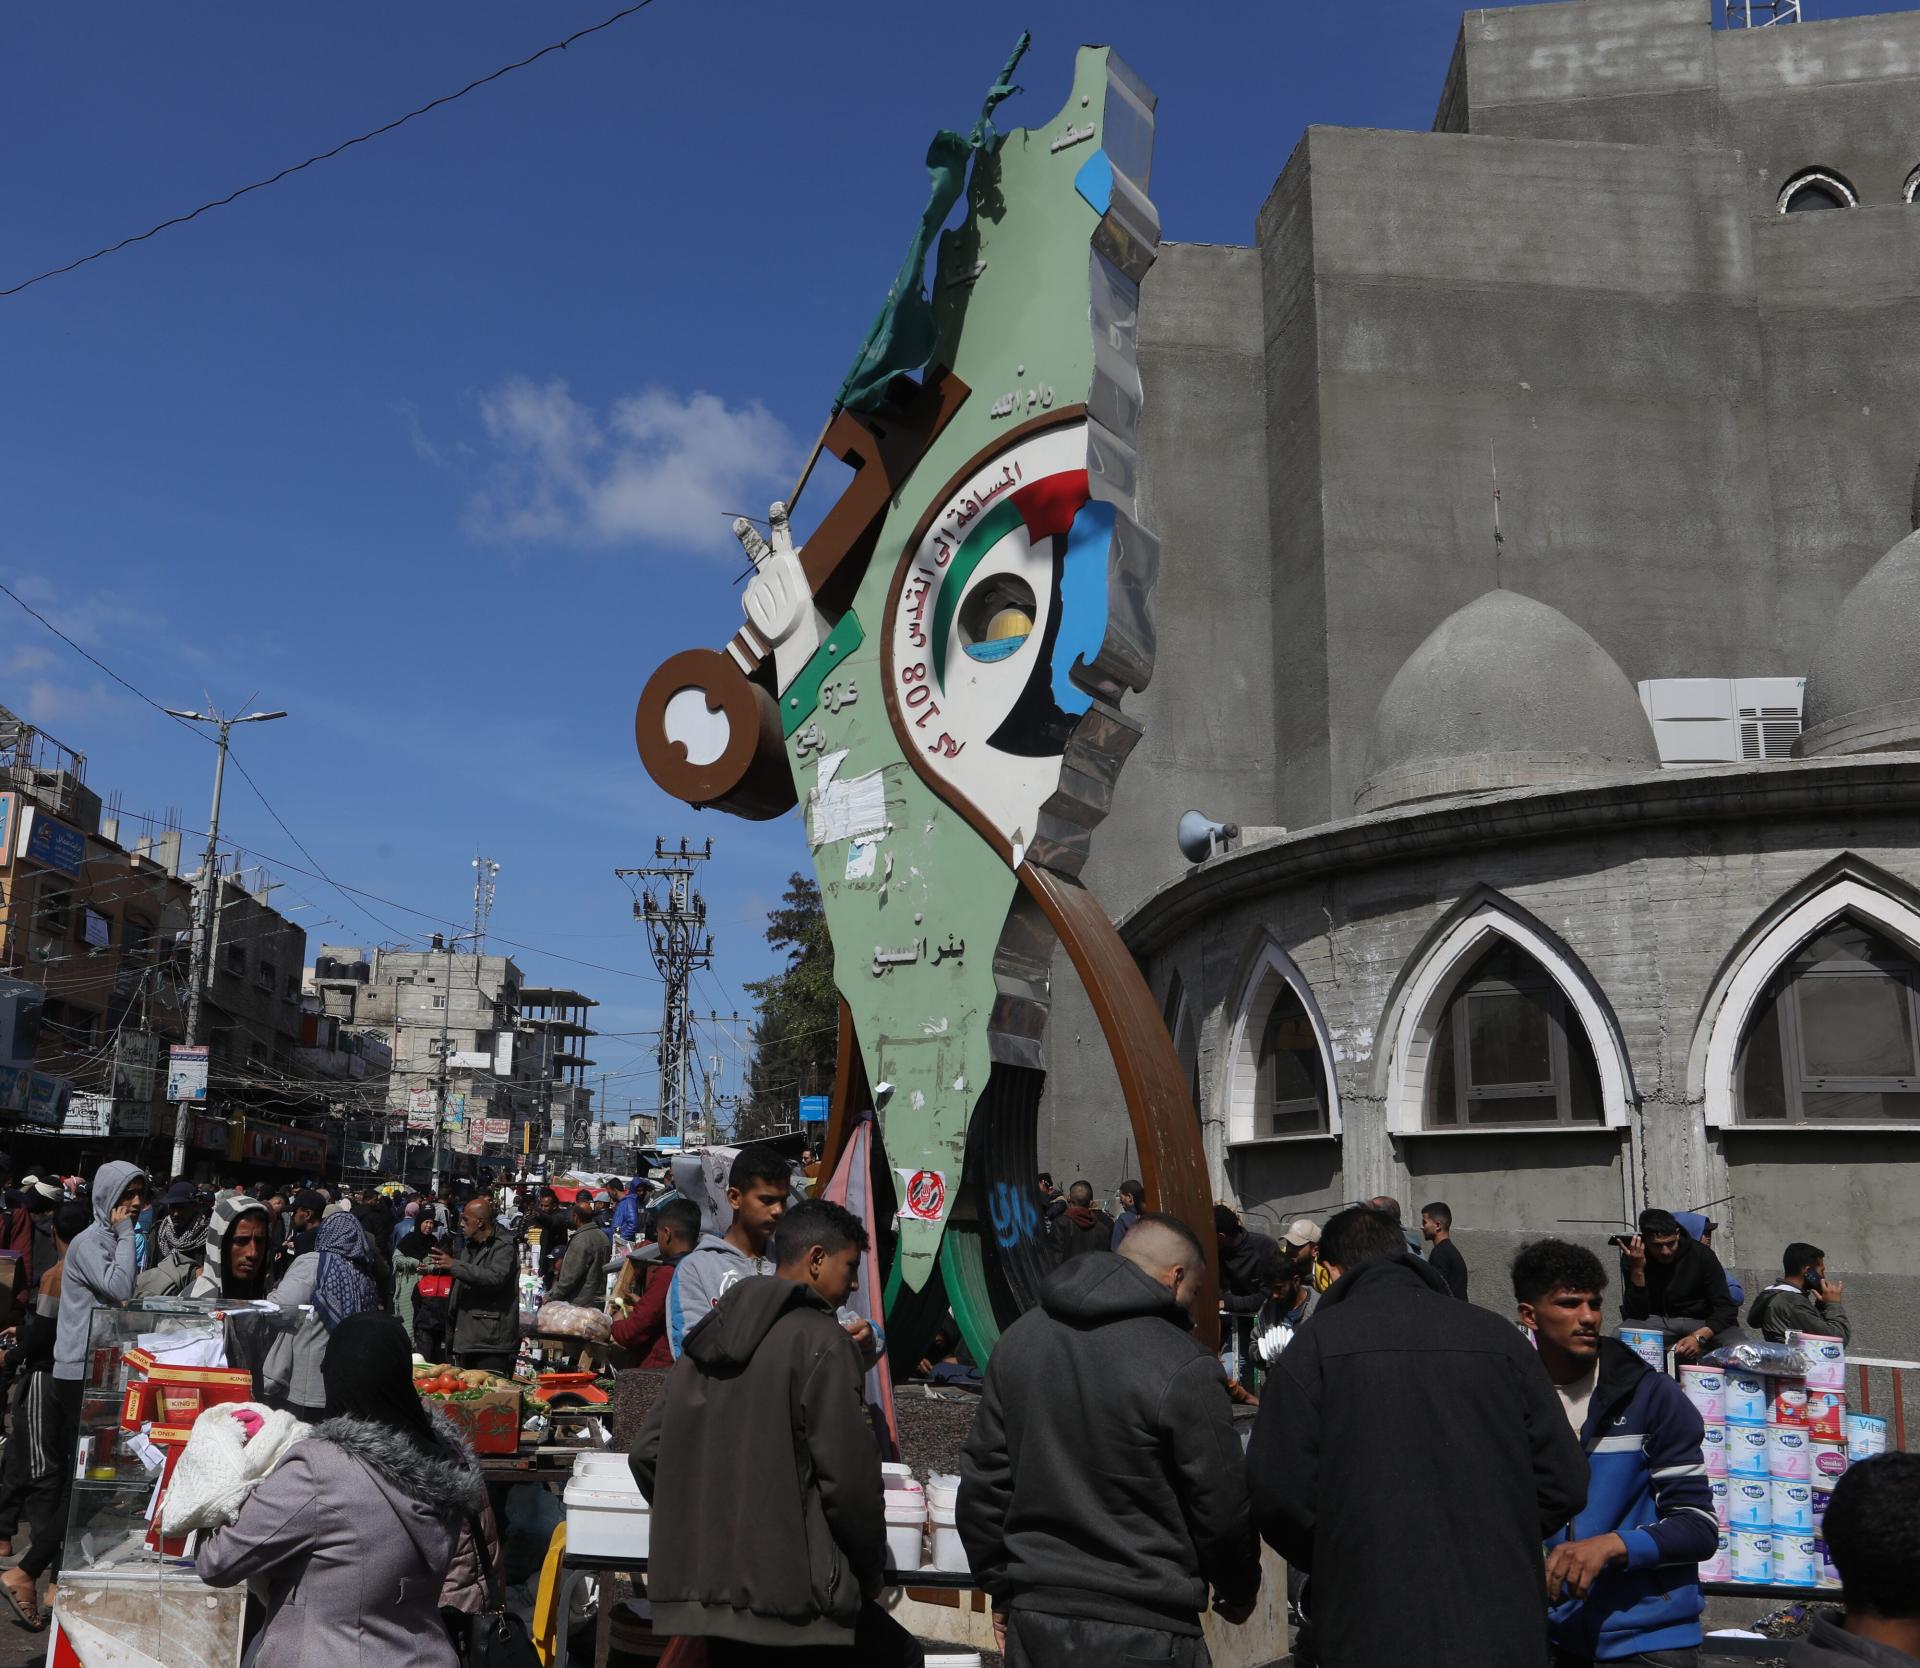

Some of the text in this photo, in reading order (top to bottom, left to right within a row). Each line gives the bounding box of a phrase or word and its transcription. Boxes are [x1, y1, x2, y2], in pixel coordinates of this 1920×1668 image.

[990, 382, 1054, 420] رام الله
[946, 461, 1023, 529] المسافة
[905, 567, 936, 648] القدس
[901, 662, 941, 729] 108
[927, 732, 967, 759] كم
[1827, 1367, 1836, 1382] 2
[1706, 1399, 1717, 1415] 2
[1745, 1401, 1753, 1417] 1
[1782, 1436, 1802, 1445] Hero
[1710, 1451, 1720, 1467] 2
[1753, 1454, 1761, 1470] 1
[1786, 1456, 1797, 1472] 2
[1744, 1487, 1764, 1496] Hero
[1789, 1489, 1808, 1498] Hero
[1717, 1504, 1726, 1519] 2
[1749, 1506, 1758, 1522] 1
[1795, 1509, 1803, 1525] 1
[1716, 1559, 1725, 1575] 2
[1761, 1560, 1768, 1577] 1
[1807, 1563, 1814, 1577] 1
